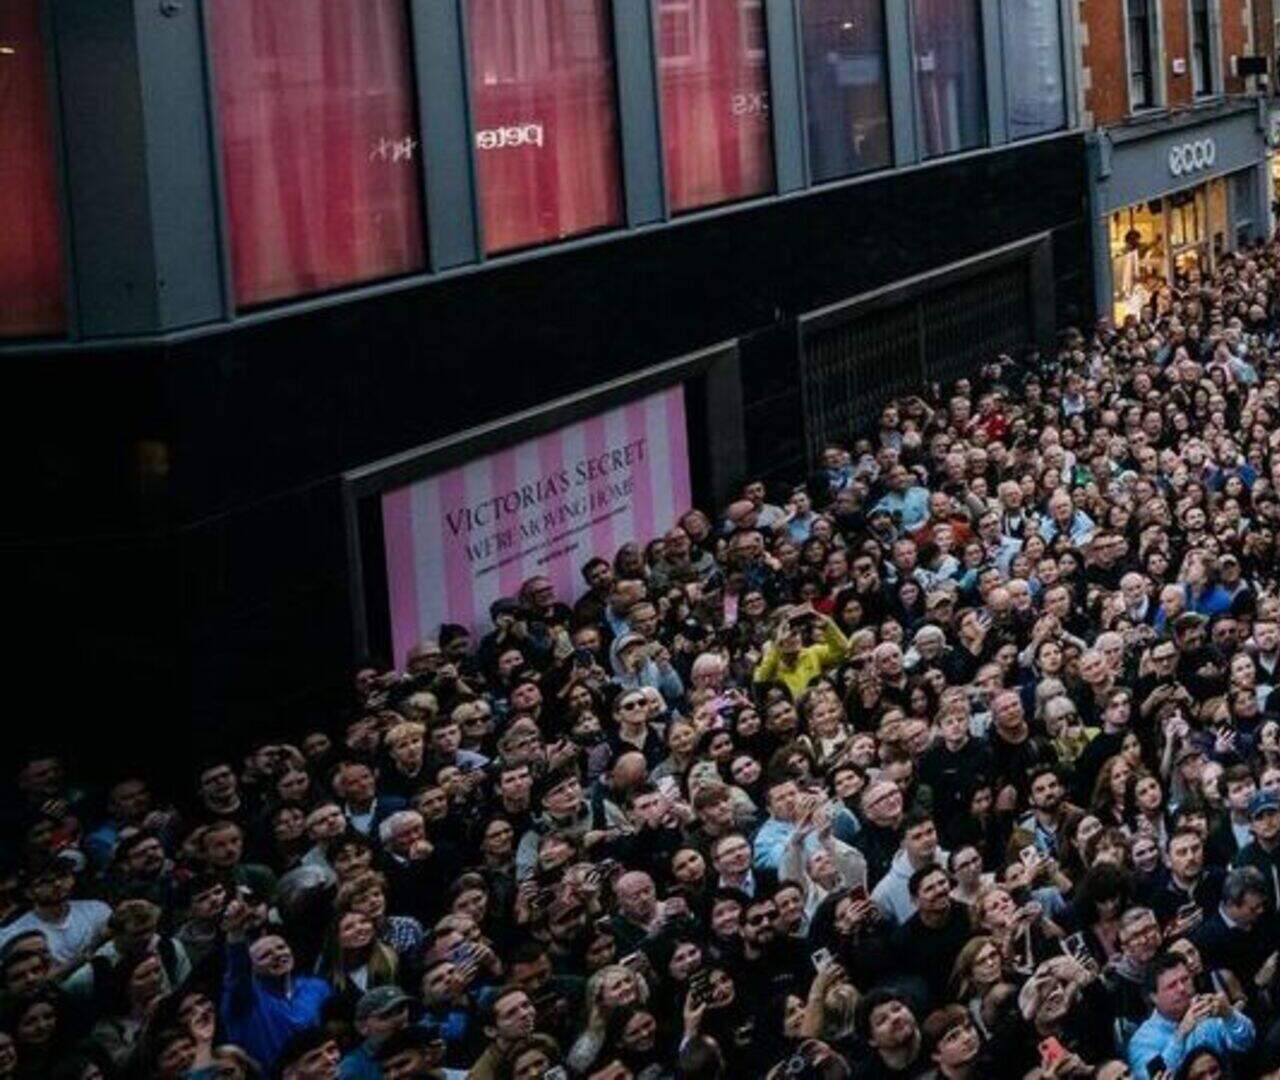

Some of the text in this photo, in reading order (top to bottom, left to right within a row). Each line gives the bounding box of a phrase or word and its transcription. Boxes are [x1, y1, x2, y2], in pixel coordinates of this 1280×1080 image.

[1168, 139, 1215, 175] ecco
[445, 438, 647, 536] VICTORIA'S SECRET
[520, 499, 587, 539] MOVING
